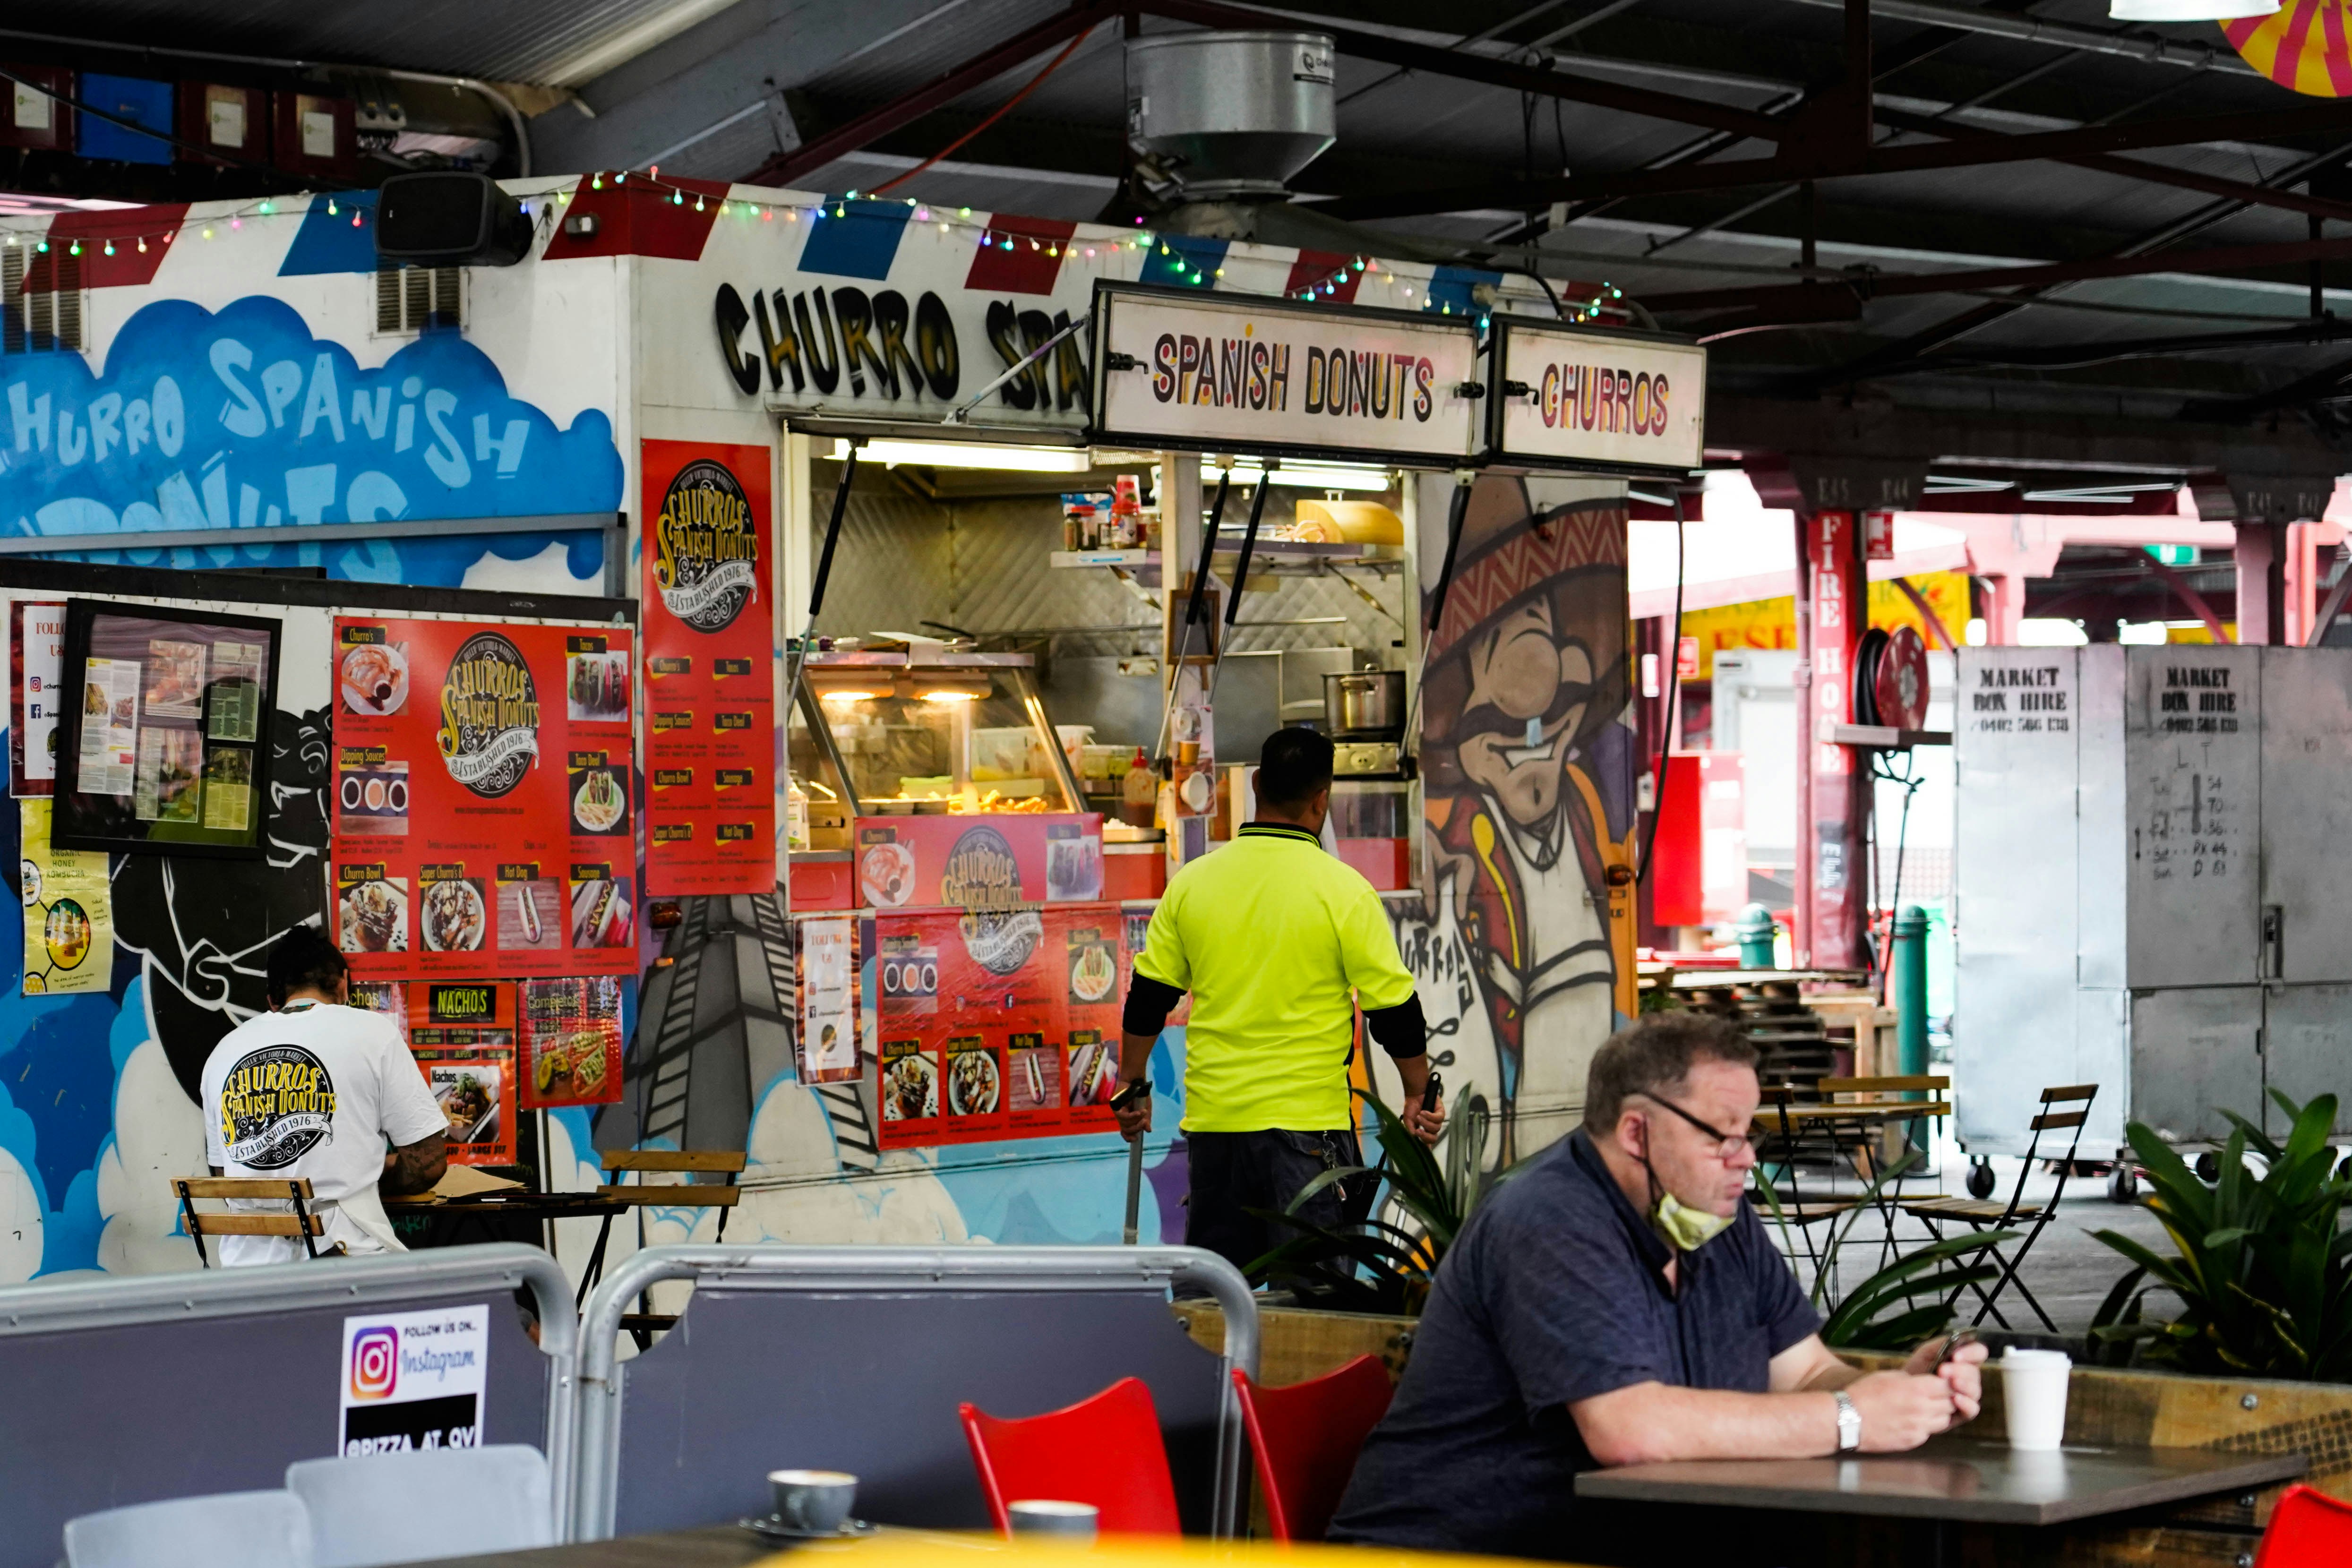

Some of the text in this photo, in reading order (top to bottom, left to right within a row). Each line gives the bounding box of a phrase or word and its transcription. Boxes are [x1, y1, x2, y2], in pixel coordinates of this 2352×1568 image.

[715, 282, 1090, 411] CHURRO SPA
[1306, 346, 1434, 421] DONUTS
[1541, 363, 1669, 437] CHURROS
[0, 375, 185, 466] HURRO
[669, 489, 746, 533] CHURROS
[655, 514, 758, 589] SPANISH DONUTS
[1817, 516, 1843, 629] FIRE
[675, 566, 741, 611] ESTABLISHED 1976
[350, 628, 373, 642] Churro's
[579, 639, 593, 651] Tacos
[452, 660, 528, 703] CHURROS
[1980, 666, 2060, 688] MARKET
[2167, 667, 2230, 688] MARKET
[1974, 692, 2067, 711] BOX HIRE
[2162, 692, 2237, 713] BOX HIRE
[439, 684, 540, 757] SPANISH DONUTS
[341, 748, 385, 764] Dipping Sauces
[459, 734, 523, 777] ESTABLISHED 1976
[46, 869, 85, 878] KOMBUCHA
[344, 866, 380, 880] Churro Bowl
[421, 866, 434, 881] Super
[437, 865, 458, 879] Churro's
[505, 865, 528, 881] Hot Dog
[578, 866, 600, 881] Sausage
[438, 989, 488, 1015] NACHOS
[259, 1051, 284, 1061] VICTORIA
[285, 1050, 307, 1062] MARKET
[229, 1063, 323, 1098] CHURROS
[222, 1088, 337, 1147] SPANISH DONUTS
[235, 1115, 310, 1160] ESTABLISHED 1976
[467, 1145, 491, 1155] LARGE
[404, 1327, 440, 1337] FOLLOW
[445, 1322, 455, 1333] US
[401, 1346, 475, 1383] Instagram
